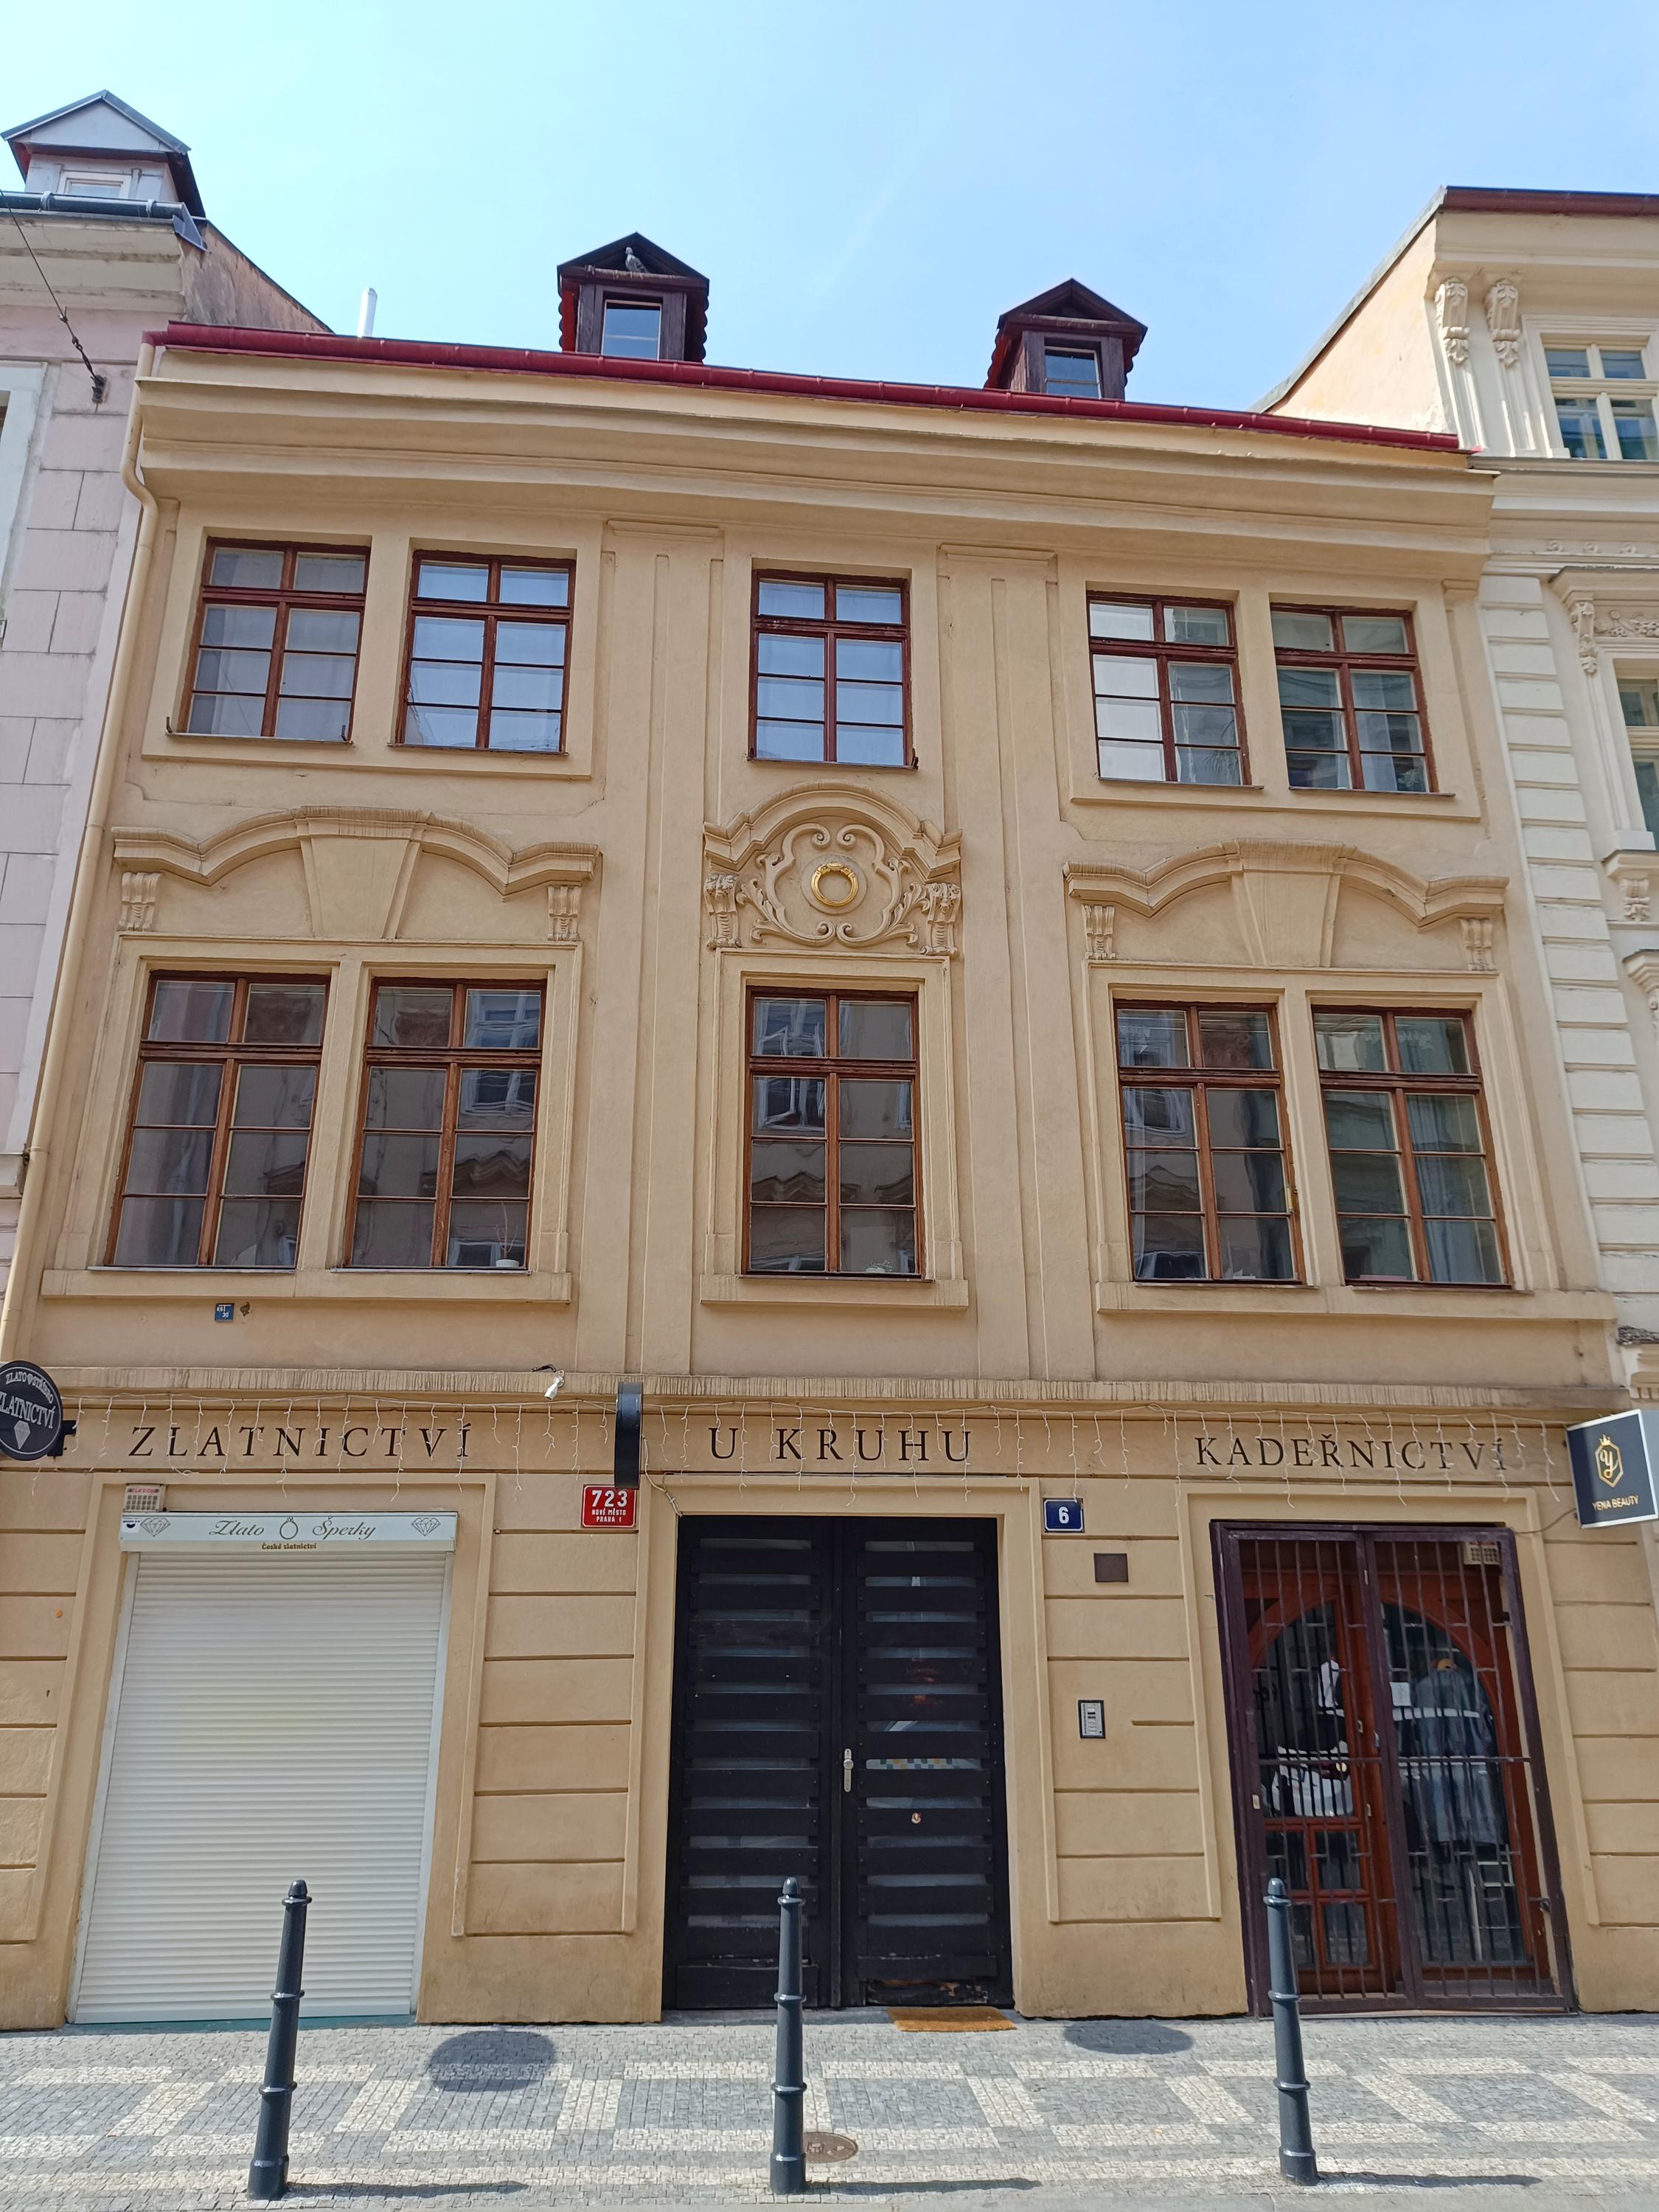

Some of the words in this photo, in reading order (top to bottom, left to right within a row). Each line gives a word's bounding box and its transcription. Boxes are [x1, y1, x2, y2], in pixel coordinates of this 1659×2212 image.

[6, 1371, 27, 1385] ZLATO
[128, 1422, 471, 1457] ZLATNICTVÍ
[709, 1427, 738, 1459] U
[776, 1428, 971, 1462] KRUHU
[1194, 1433, 1507, 1471] KADEŘNICTVÍ
[591, 1489, 627, 1507] 723
[1592, 1500, 1612, 1511] YENA
[1611, 1495, 1638, 1509] BEAUTY
[1058, 1506, 1069, 1524] 6
[209, 1520, 265, 1536] Zlato
[312, 1516, 376, 1540] Šperky
[261, 1542, 282, 1550] České
[283, 1542, 317, 1550] zlatnictví
